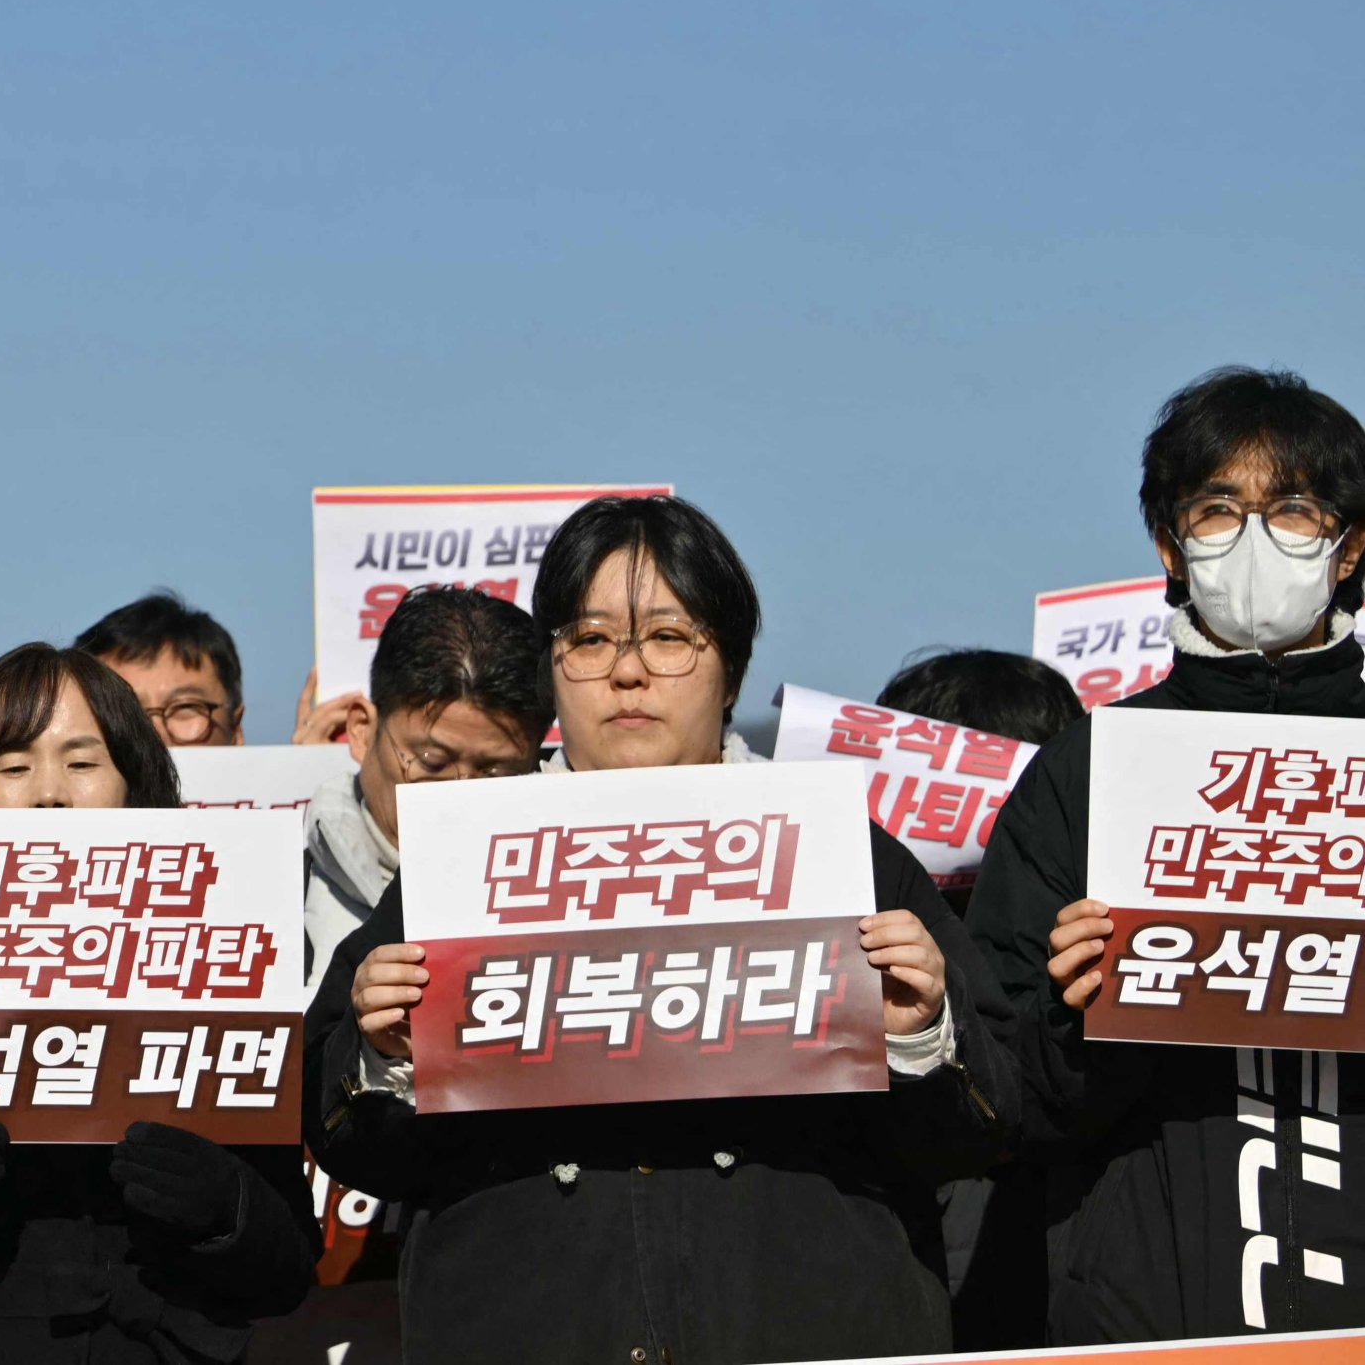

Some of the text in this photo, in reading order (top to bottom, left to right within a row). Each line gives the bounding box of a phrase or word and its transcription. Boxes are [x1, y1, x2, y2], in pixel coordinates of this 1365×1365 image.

[355, 528, 472, 572] 시민이
[1056, 618, 1126, 659] 국가
[826, 704, 1021, 781] 윤석열
[1197, 747, 1337, 826] 기후
[78, 842, 219, 918] 파탄
[484, 813, 801, 924] 민주주의
[138, 923, 278, 999] 파탄
[1118, 925, 1362, 1014] 윤석열
[460, 939, 844, 1062] 회복하라
[128, 1025, 291, 1109] 파면
